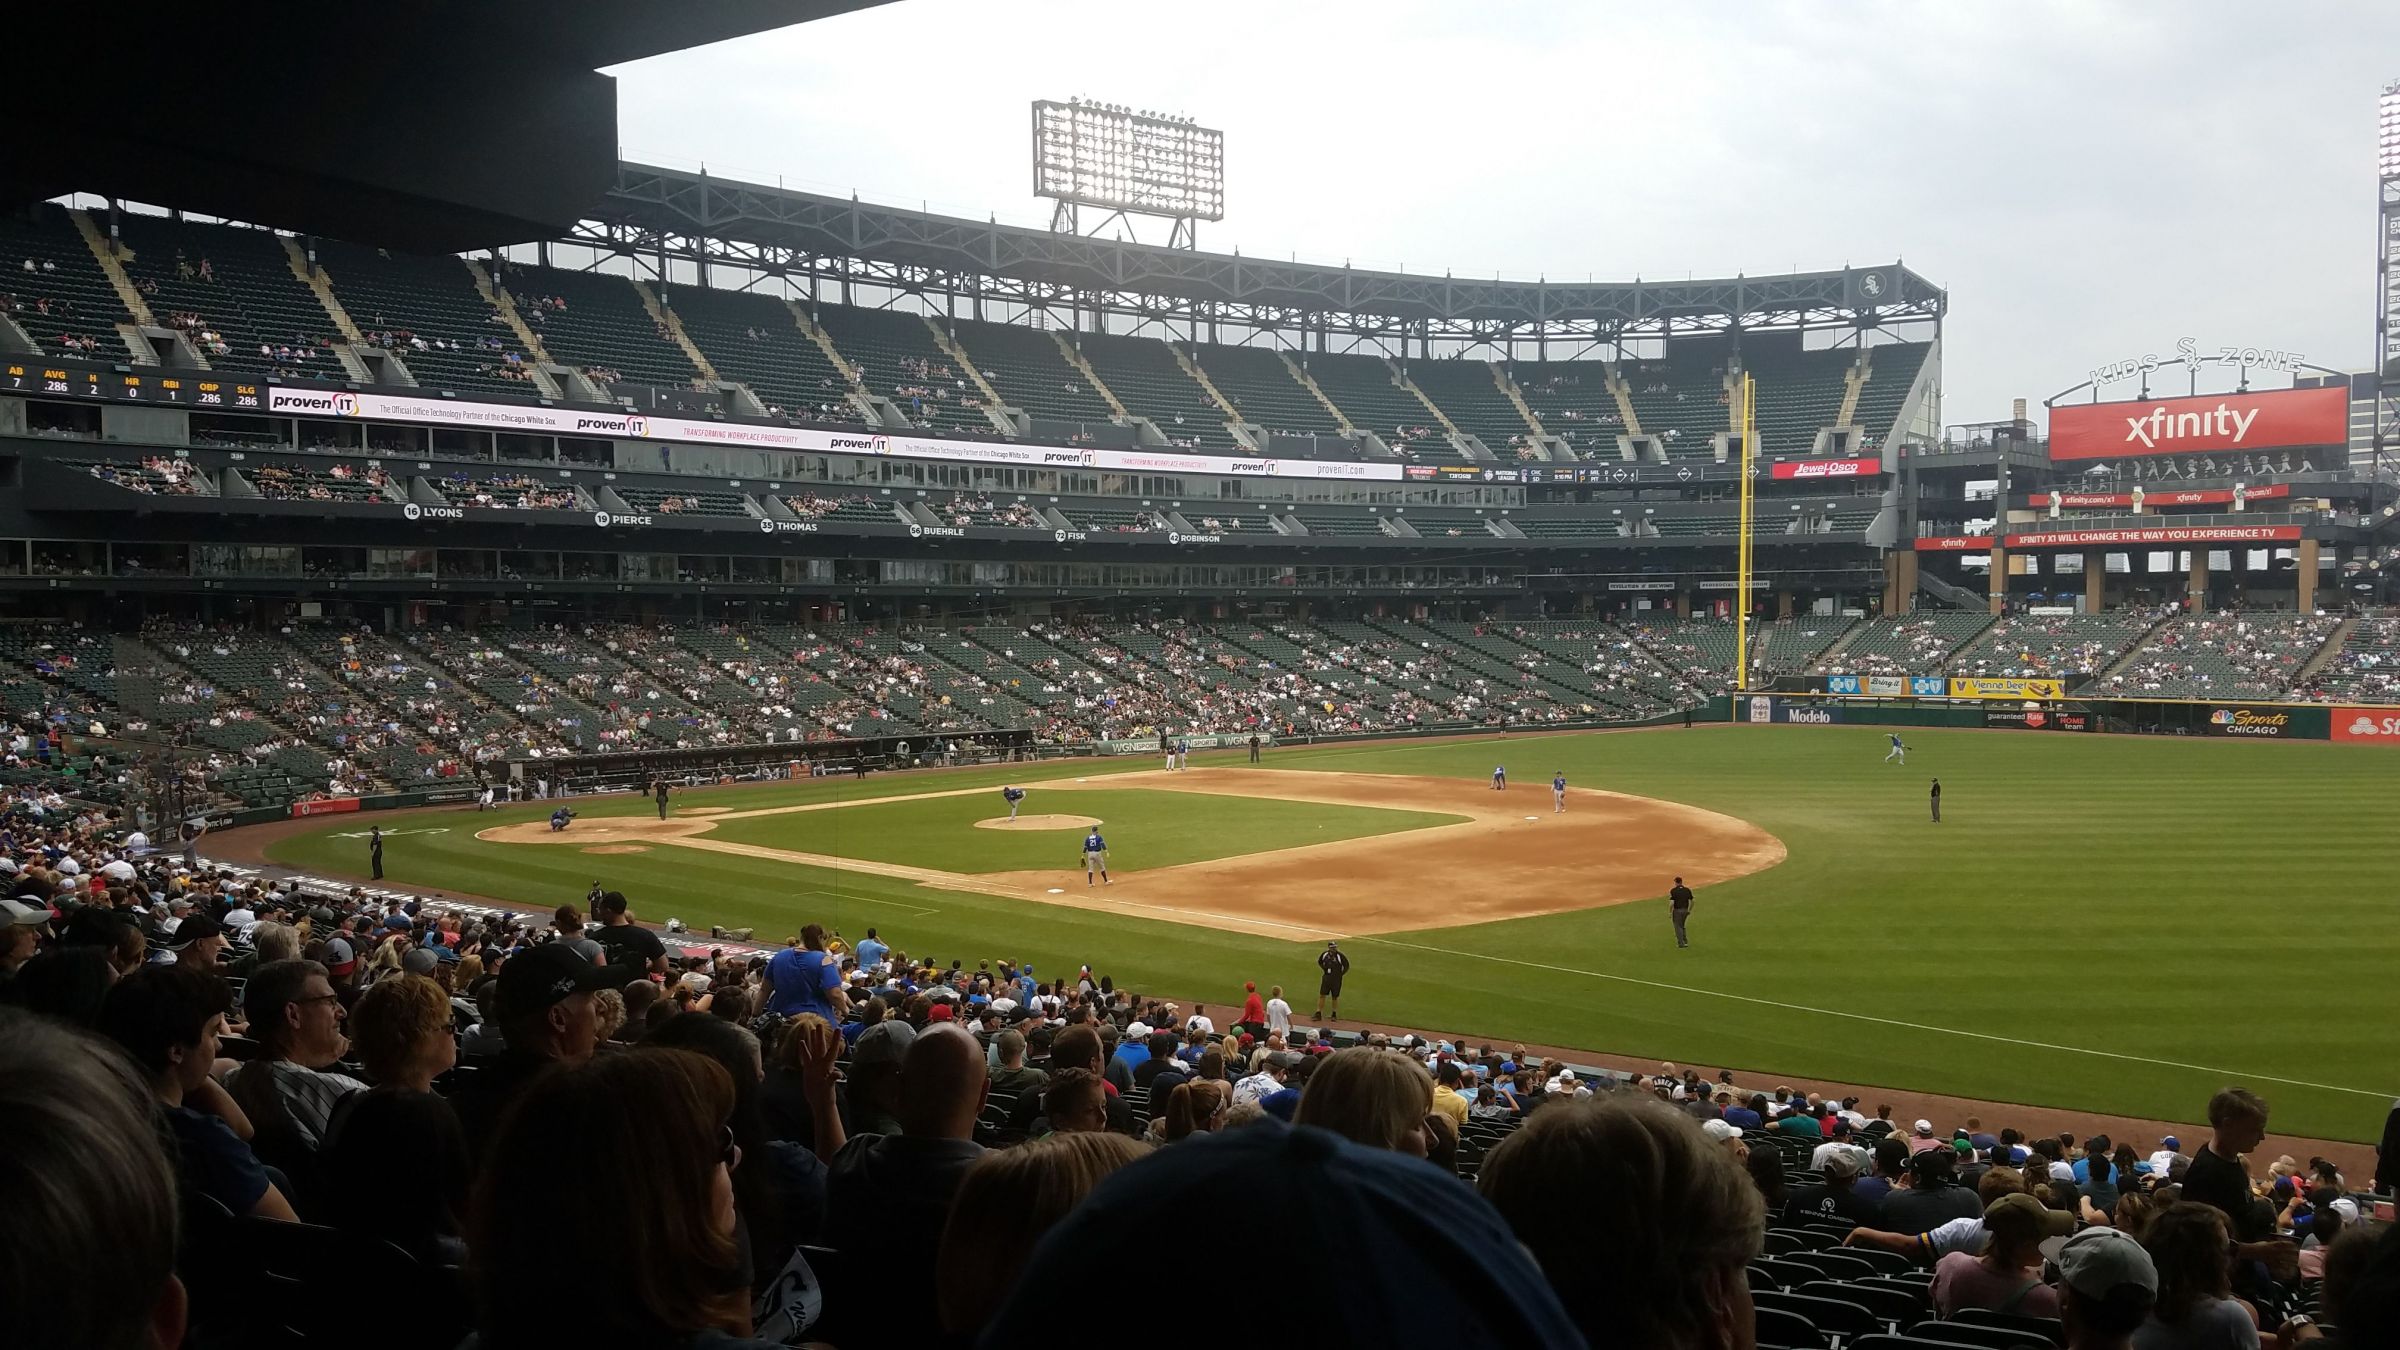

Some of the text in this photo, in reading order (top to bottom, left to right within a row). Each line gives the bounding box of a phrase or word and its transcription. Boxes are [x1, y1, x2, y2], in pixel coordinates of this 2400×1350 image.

[9, 367, 23, 376] AB
[2090, 354, 2159, 387] KIDS
[2218, 347, 2305, 375] ZONE
[44, 370, 66, 380] AVG
[90, 374, 97, 382] H
[13, 378, 21, 388] 7
[125, 377, 140, 386] HR
[163, 380, 180, 389] RBI
[44, 382, 68, 392] .286
[90, 385, 98, 395] 2
[199, 383, 219, 392] OBP
[237, 385, 255, 395] SLG
[129, 388, 137, 398] 0
[170, 391, 175, 400] 1
[198, 393, 221, 404] .286
[235, 396, 258, 406] .286
[273, 394, 352, 412] proven IT
[380, 405, 556, 425] The Official Office Technology Partner of the Chicago White Sox
[577, 418, 643, 432] proven IT
[2125, 403, 2260, 448] xfinity
[683, 428, 798, 444] TRANSFORMING WORKPLACE PRODUCTIVITY
[830, 438, 887, 450] proven IT
[1044, 452, 1092, 463] proven IT
[1231, 462, 1275, 473] proven IT
[1317, 463, 1365, 477] provenIT.com
[2066, 496, 2115, 504] xfinity.com/x1
[2177, 494, 2202, 502] xfinity
[407, 507, 463, 518] 16 LYONS
[597, 515, 652, 525] 19 PIERCE
[762, 521, 817, 532] 35 THOMAS
[911, 526, 965, 536] 56 BUEHRLE
[1056, 531, 1086, 540] 72 FISK
[1170, 534, 1220, 543] 42 ROBINSON
[2019, 529, 2275, 544] XFINITY X1 WILL CHANGE THE WAY YOU EXPERIENCE TV
[1941, 538, 1966, 549] xfinity
[1871, 677, 1892, 688] Bring
[1972, 680, 2027, 689] Vienna Beef
[1789, 709, 1830, 723] Modelo
[1987, 713, 2025, 721] guaranteed
[2234, 709, 2288, 727] Sports
[2227, 725, 2278, 735] CHICAGO
[1194, 738, 1217, 747] SPORTS
[1225, 736, 1246, 745] WGN
[1112, 742, 1136, 752] WGN
